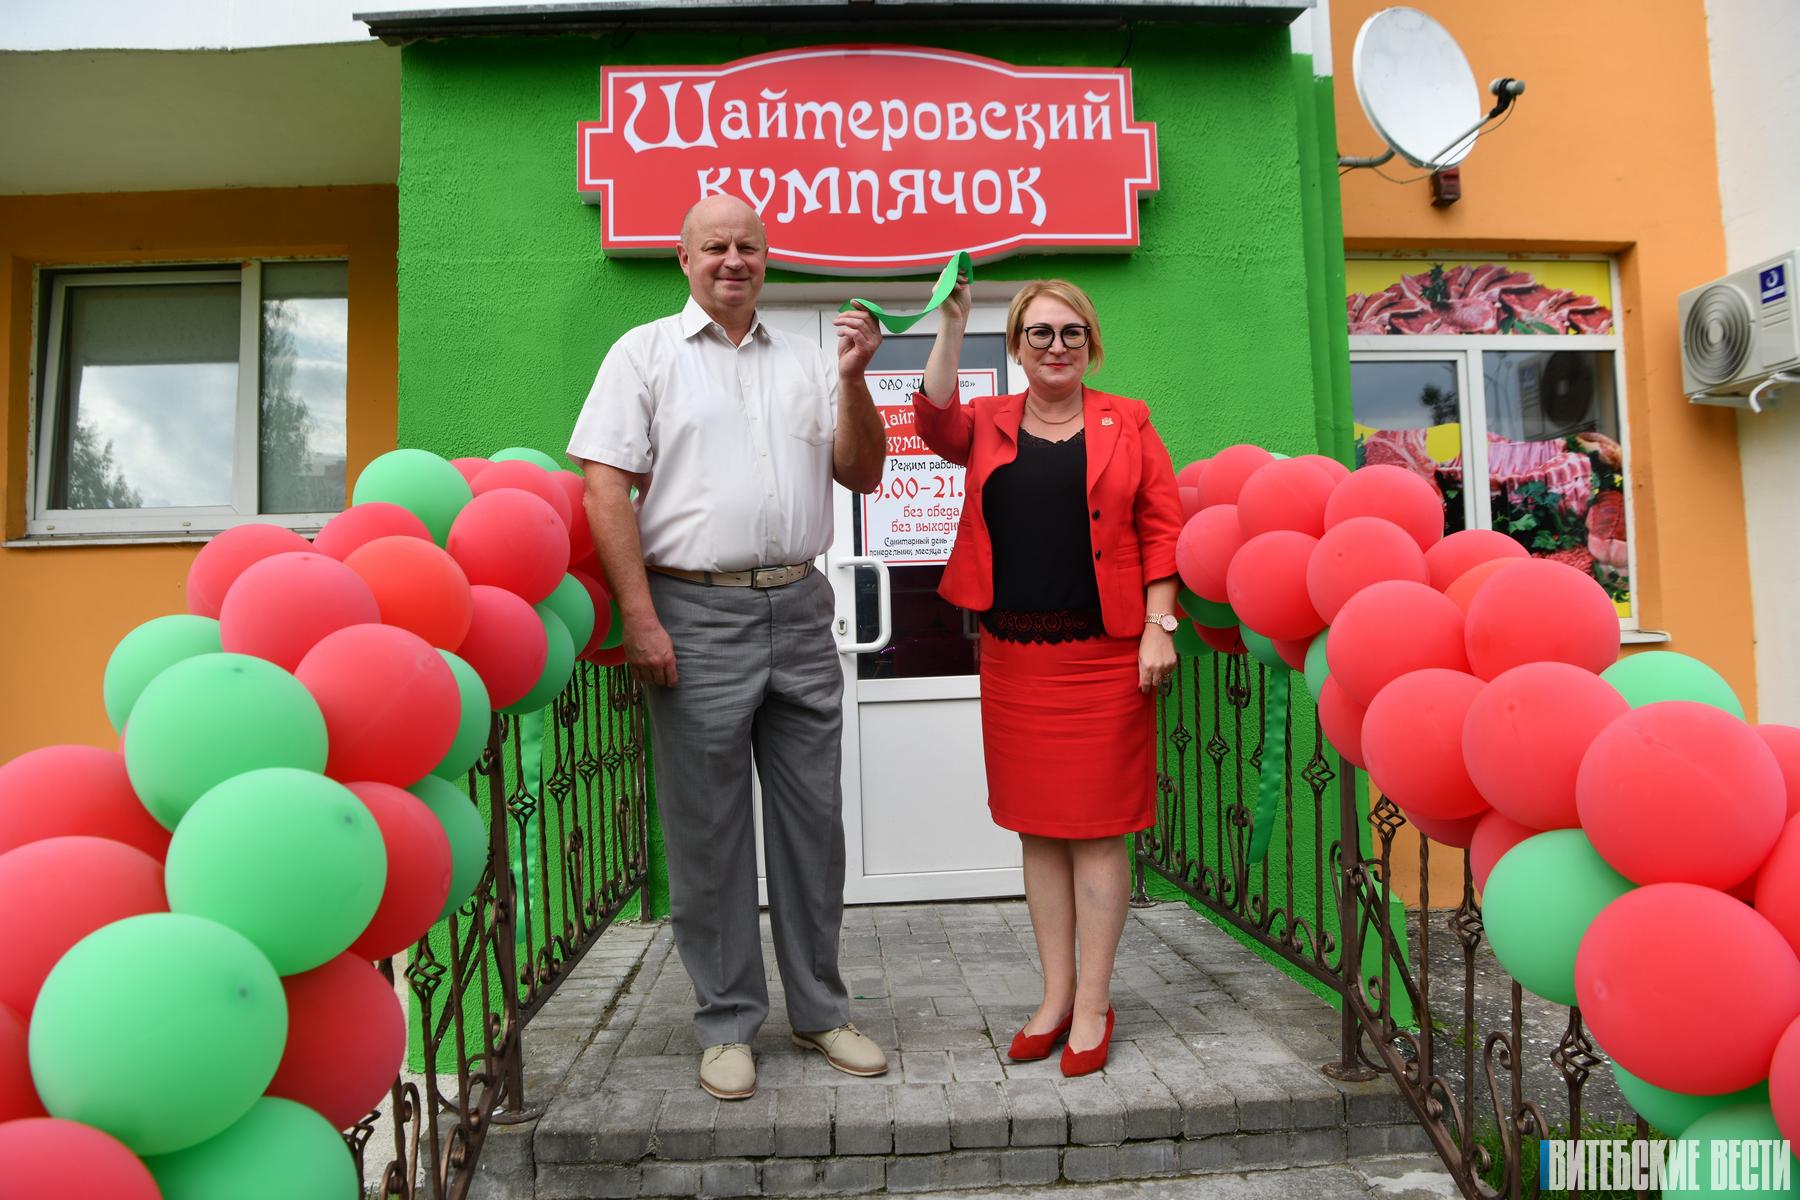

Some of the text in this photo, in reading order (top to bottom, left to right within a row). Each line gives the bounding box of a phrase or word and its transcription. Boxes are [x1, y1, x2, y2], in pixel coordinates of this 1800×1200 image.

[624, 80, 1112, 153] Шайтеровский
[879, 378, 903, 391] ОАО
[890, 458, 926, 472] Режим
[903, 503, 960, 520] без обеда
[891, 519, 912, 532] без
[931, 538, 948, 546] день
[915, 547, 942, 556] месяца
